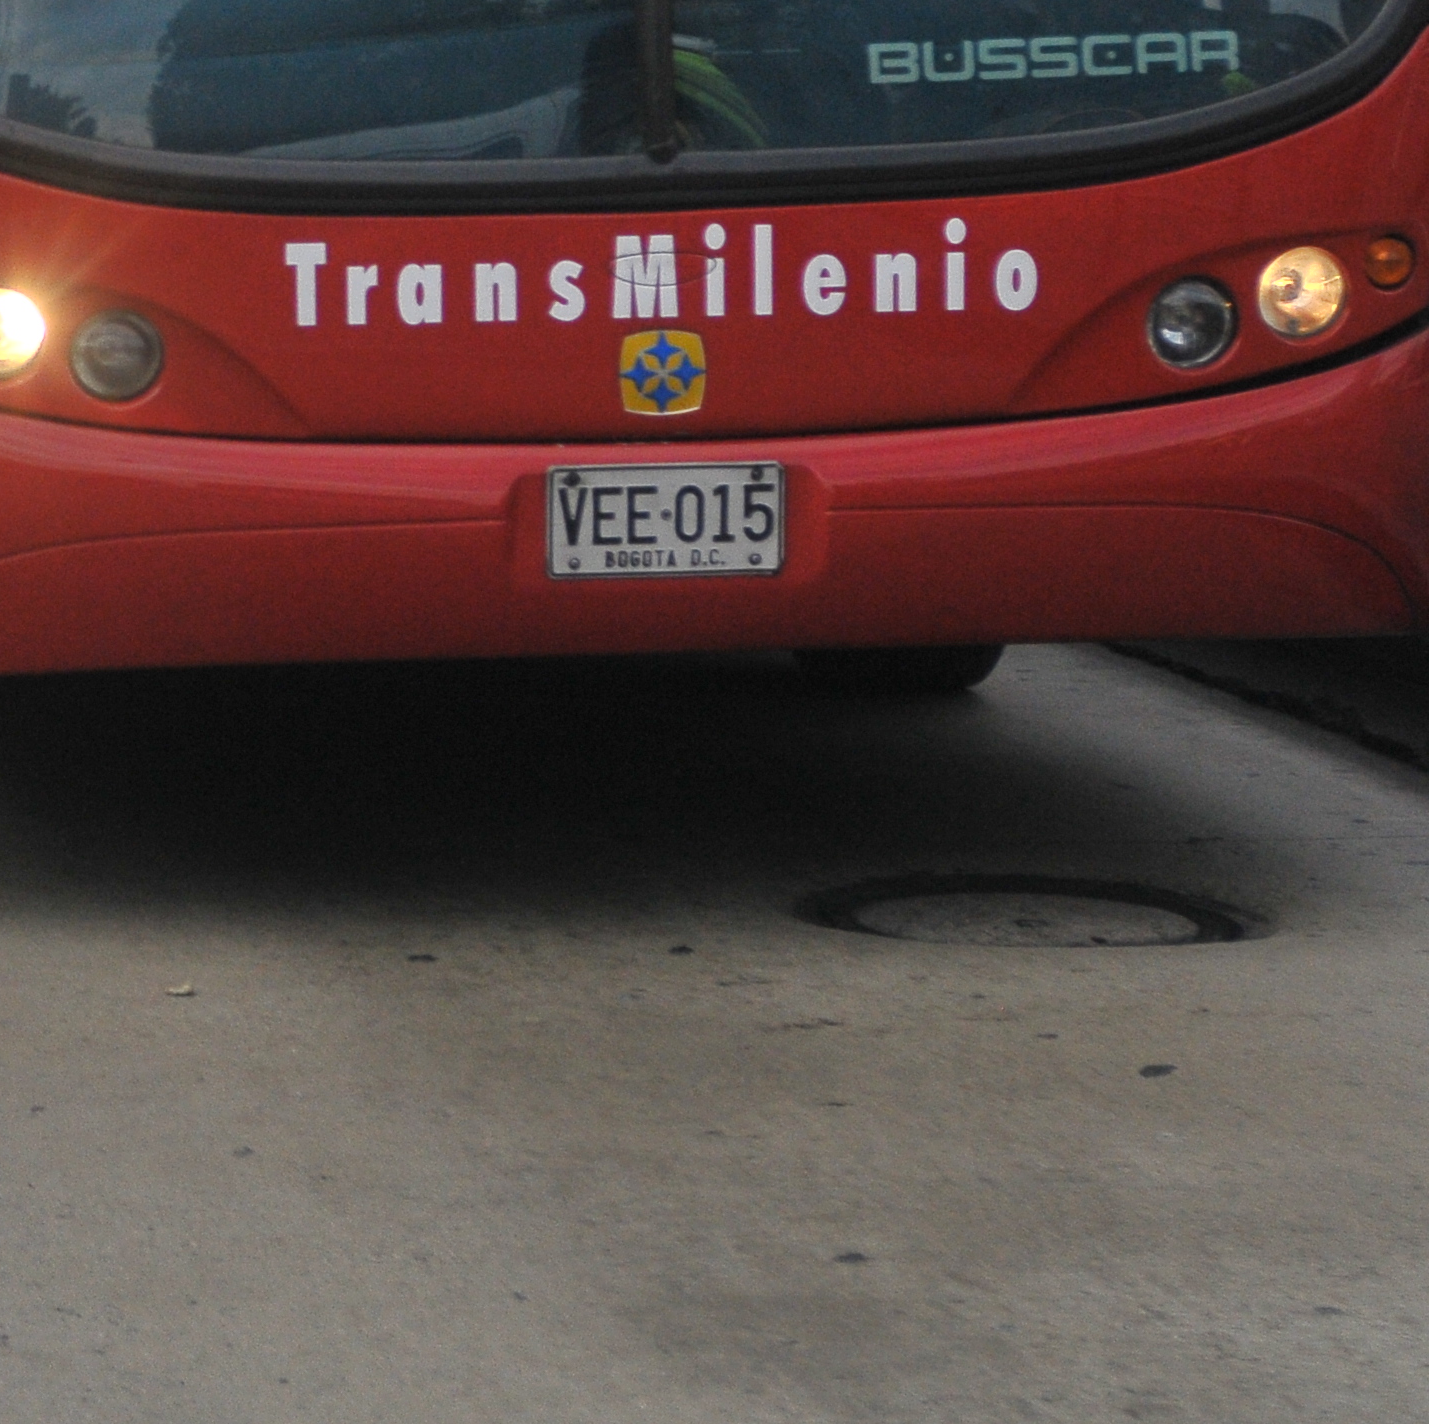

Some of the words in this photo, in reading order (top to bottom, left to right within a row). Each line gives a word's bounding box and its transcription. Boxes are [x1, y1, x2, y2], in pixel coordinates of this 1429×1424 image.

[866, 29, 1240, 84] BUSSCAR
[284, 217, 1039, 328] TransMilenio
[604, 549, 677, 569] BOGOTA
[690, 548, 727, 567] D.C.
